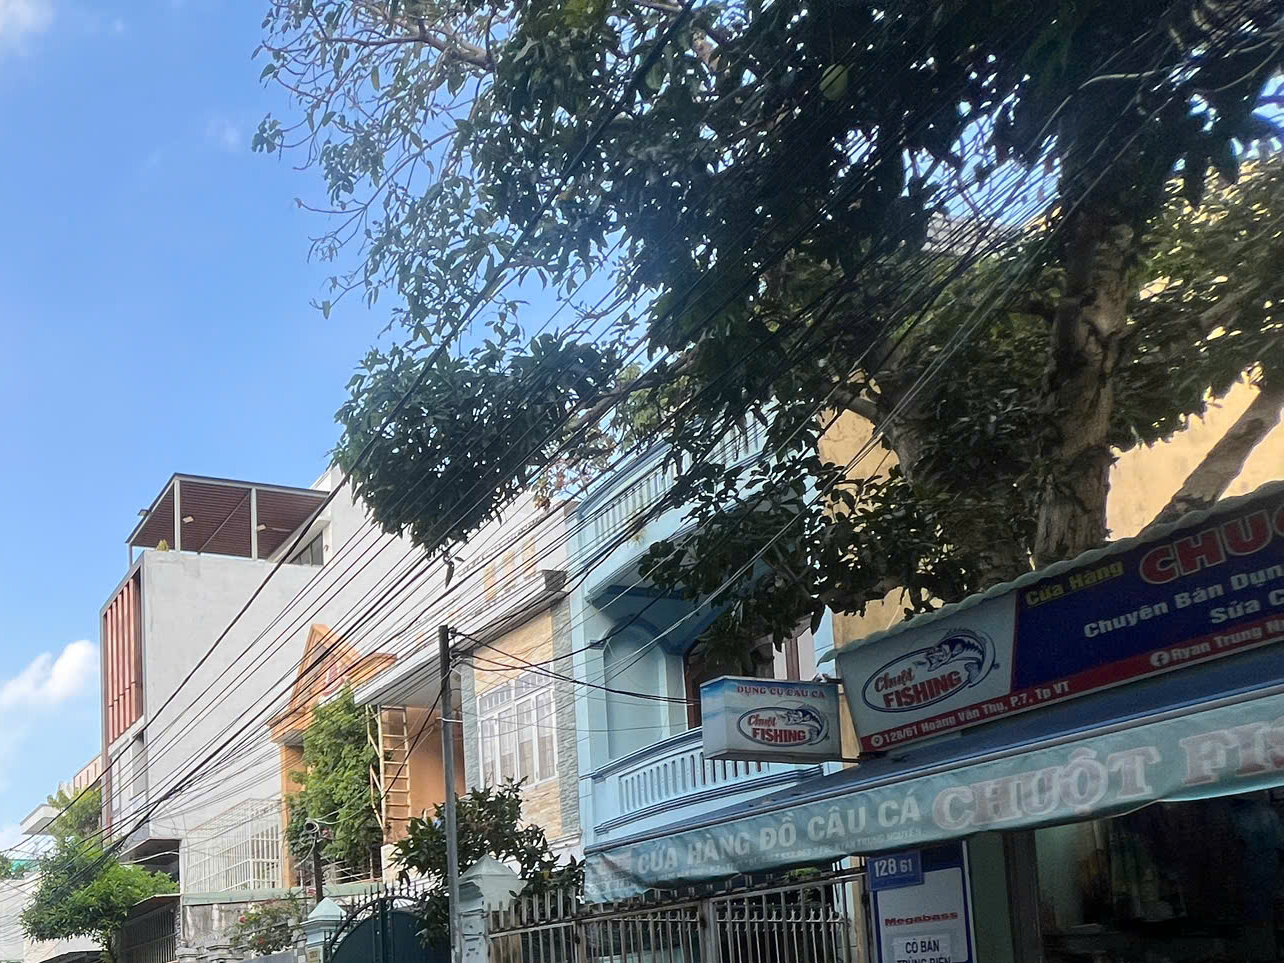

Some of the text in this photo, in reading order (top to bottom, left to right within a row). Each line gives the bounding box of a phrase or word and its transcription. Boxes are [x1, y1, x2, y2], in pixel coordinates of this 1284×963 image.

[1138, 503, 1284, 585] CHU
[1069, 561, 1124, 590] Hàng
[1083, 600, 1169, 638] Chuyên
[1173, 582, 1225, 609] Bán
[1210, 599, 1260, 624] Sửa
[1214, 627, 1262, 649] Trung
[882, 670, 963, 708] FISHING
[752, 727, 806, 743] FISHING
[883, 725, 918, 743] 128/61
[932, 747, 1161, 830] CHUỘT
[687, 832, 750, 865] HÀNG
[759, 811, 797, 851] ĐỒ
[807, 806, 866, 842] CÂU
[878, 788, 921, 828] CÁ
[874, 858, 913, 877] 128 61
[884, 912, 958, 926] Megabass
